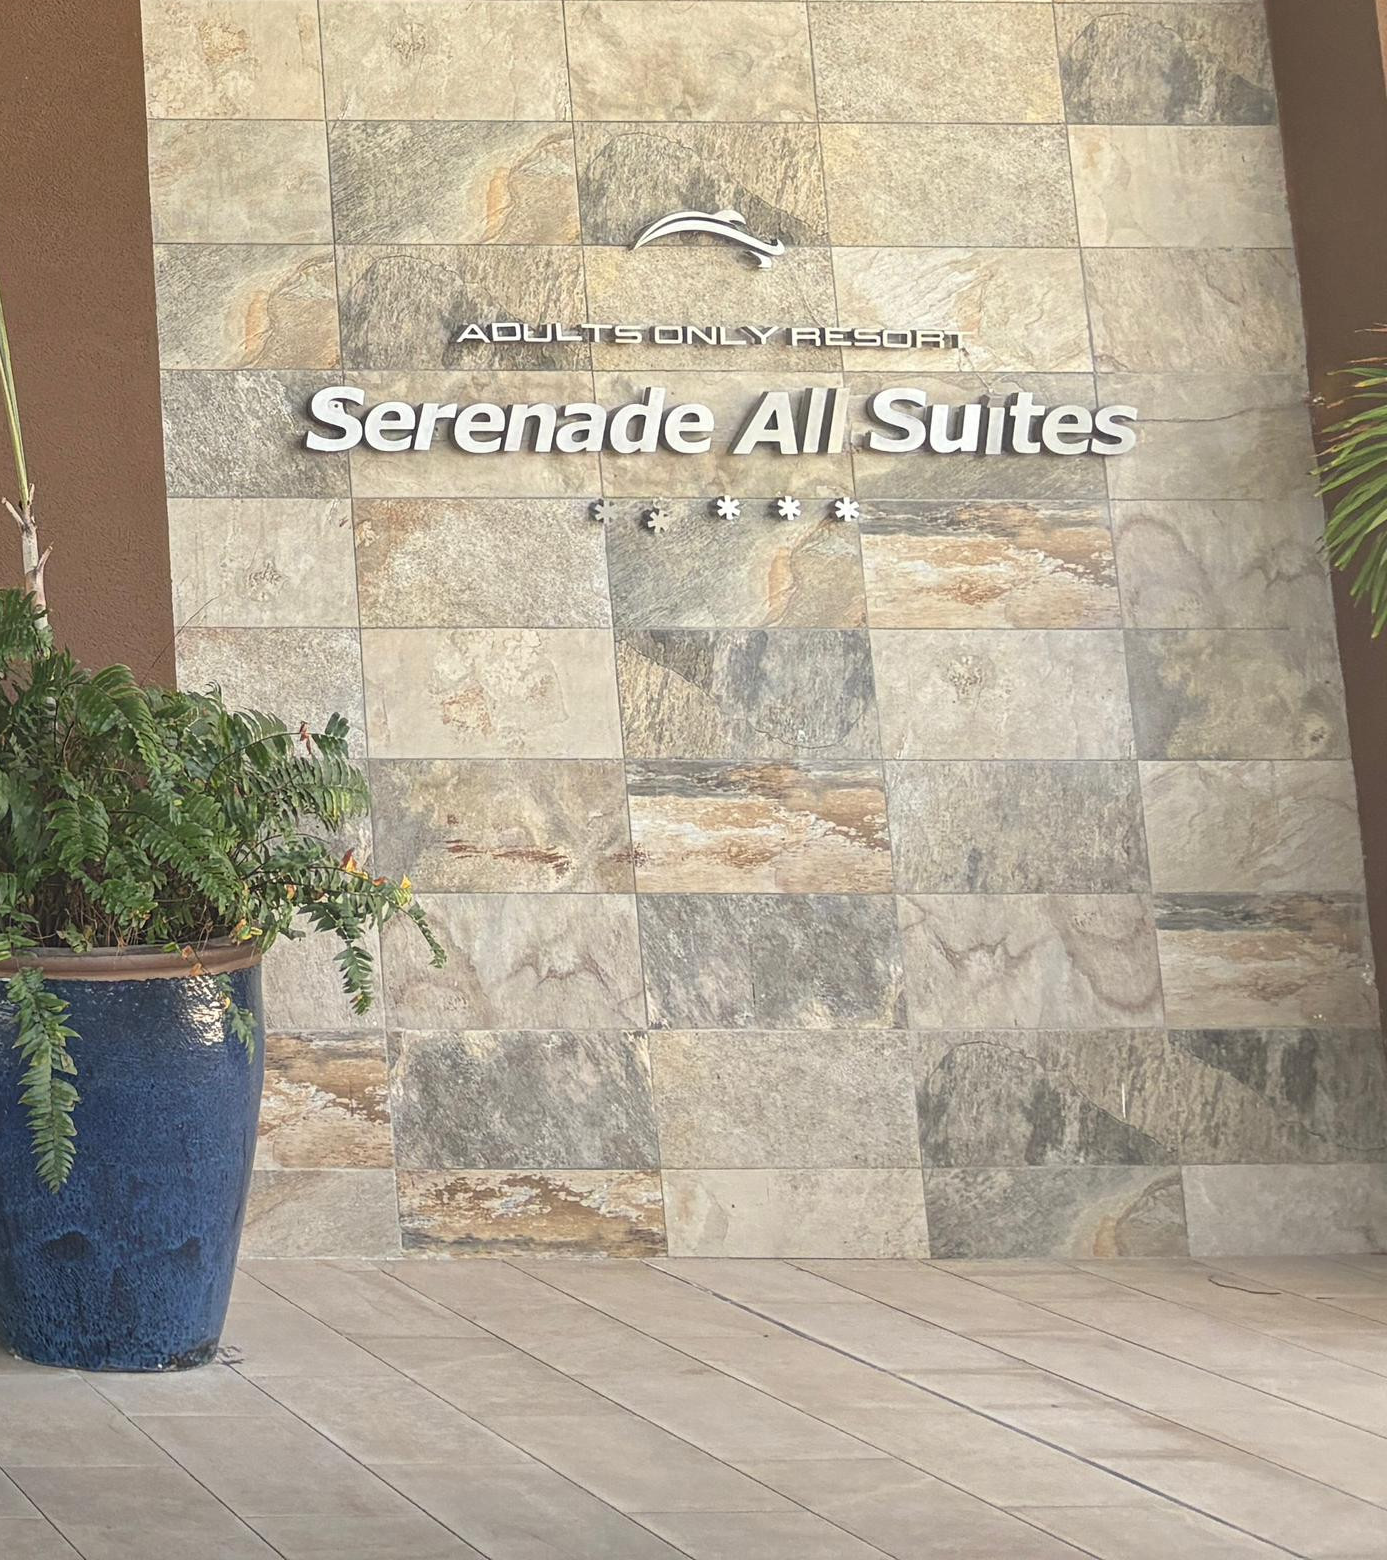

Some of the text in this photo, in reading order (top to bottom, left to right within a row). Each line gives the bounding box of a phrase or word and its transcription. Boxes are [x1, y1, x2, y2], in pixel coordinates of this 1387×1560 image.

[455, 321, 975, 350] ADULTS ONLY RESORT
[305, 385, 1139, 457] Serenade All Suites
